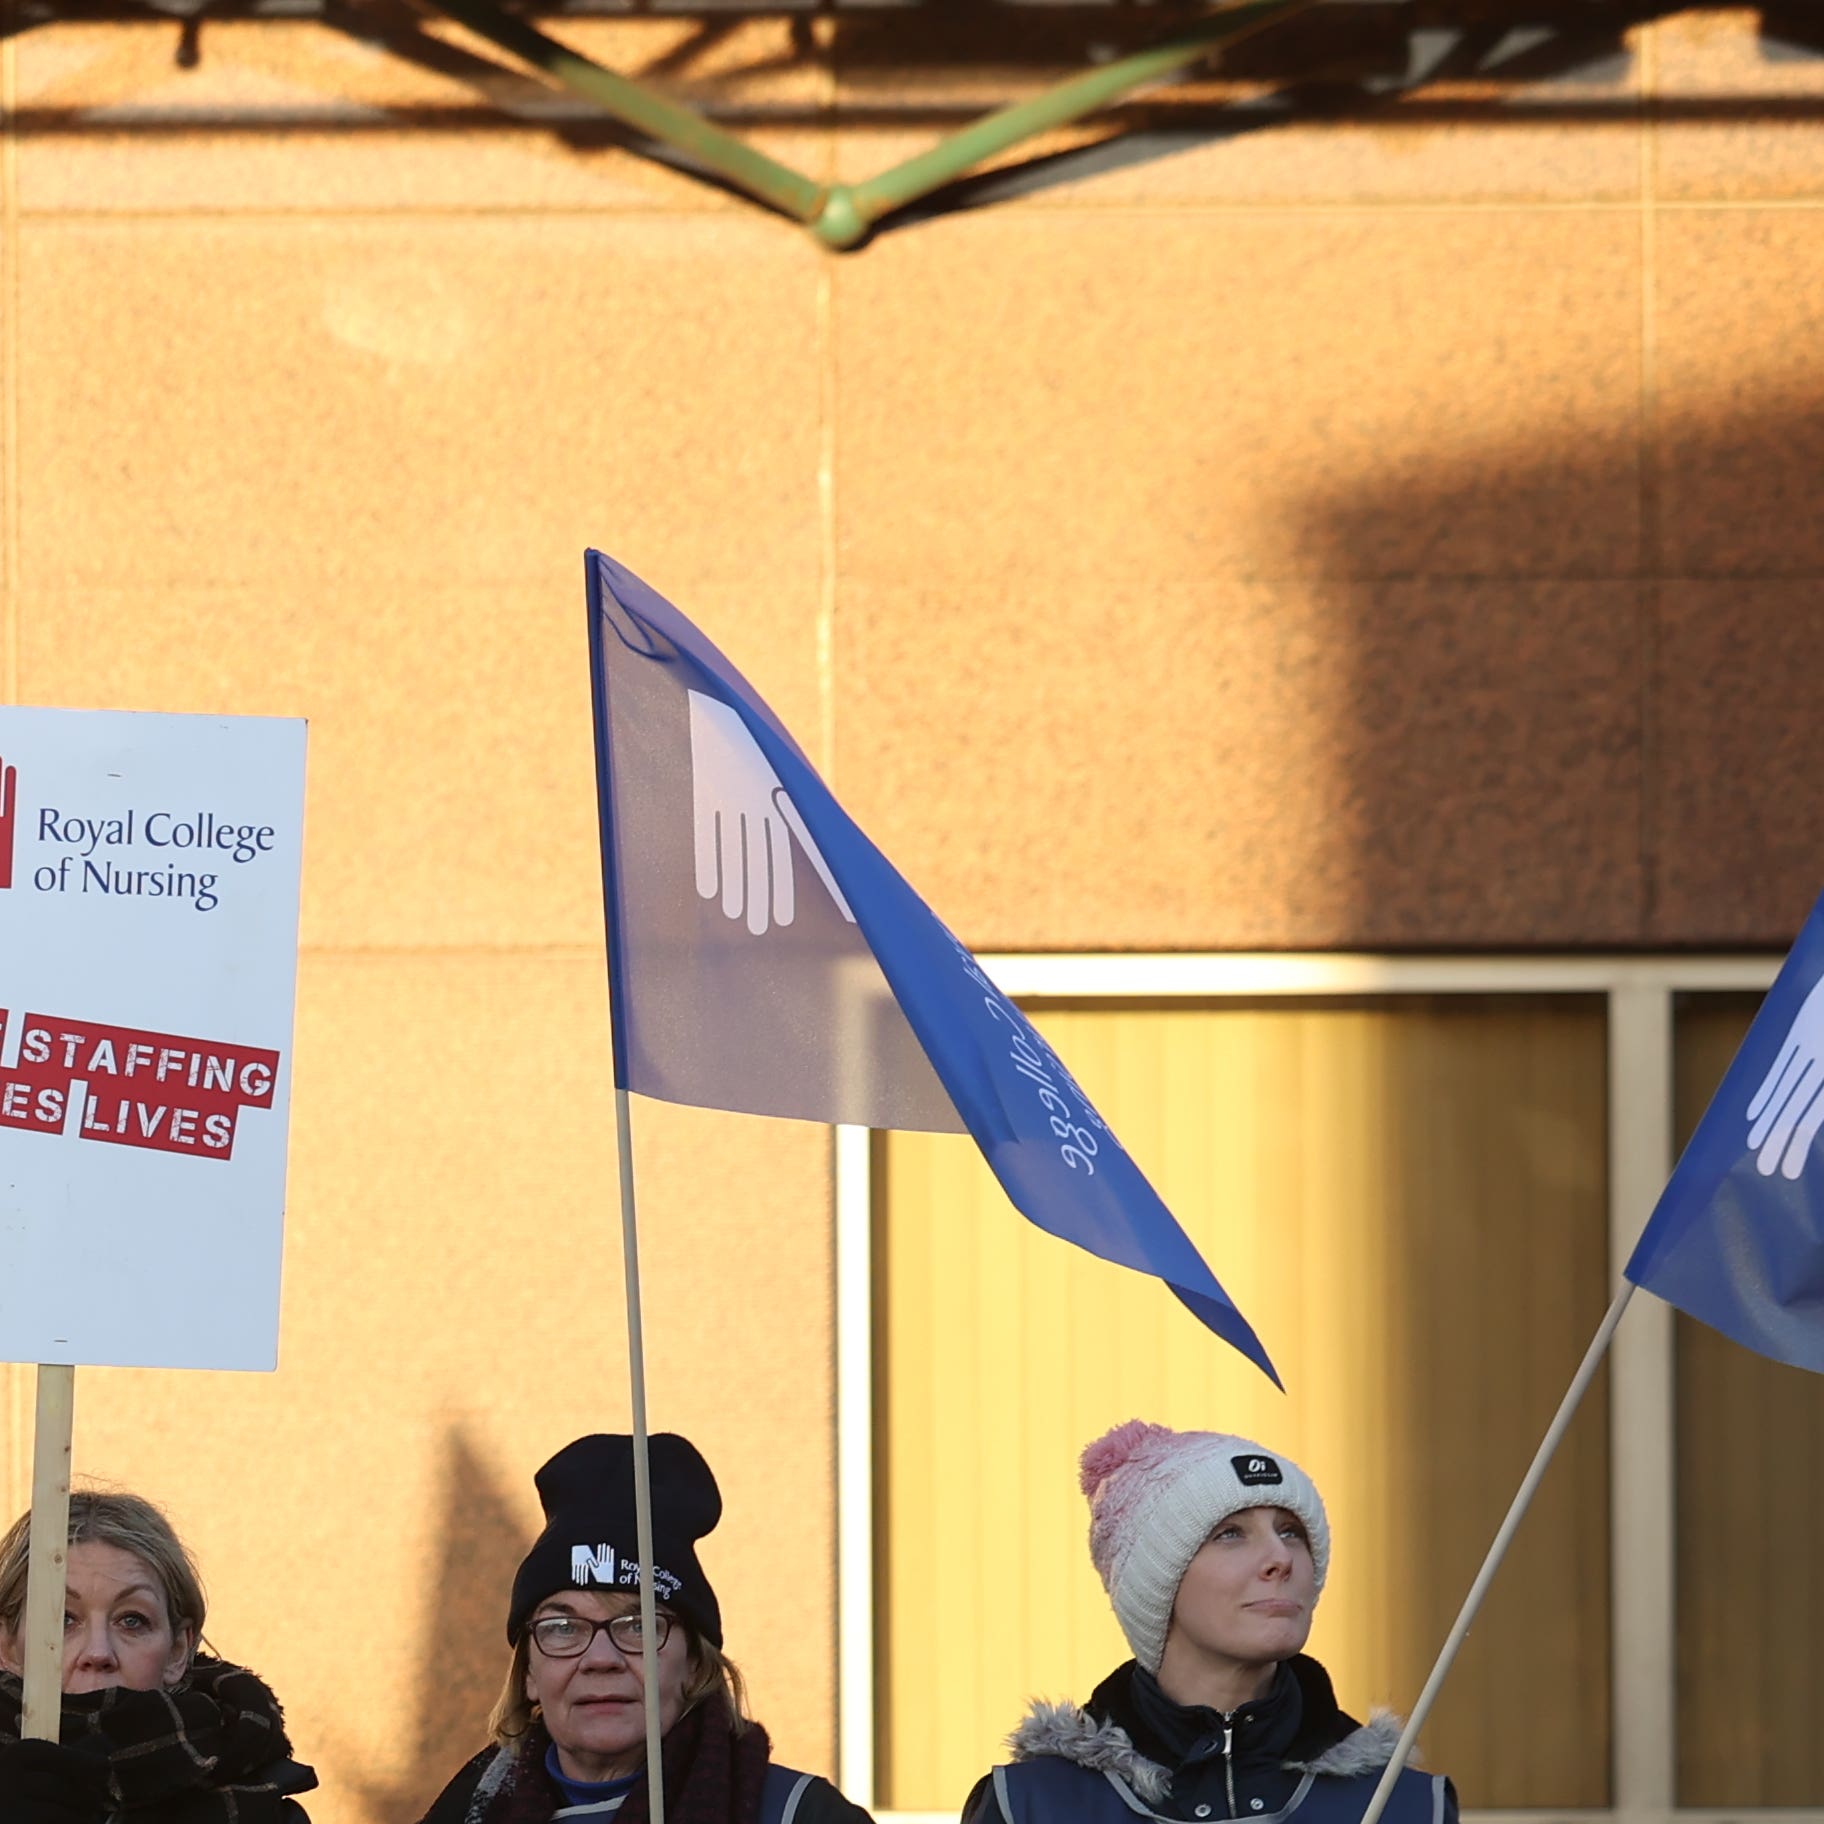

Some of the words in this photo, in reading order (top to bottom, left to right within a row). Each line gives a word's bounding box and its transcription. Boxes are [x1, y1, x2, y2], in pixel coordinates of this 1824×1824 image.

[38, 808, 133, 856] Royal
[145, 813, 274, 863] College
[34, 856, 73, 892] of
[82, 860, 219, 911] Nursing
[22, 1029, 273, 1097] STAFFING
[84, 1094, 232, 1150] LIVES
[621, 1559, 640, 1574] Roy
